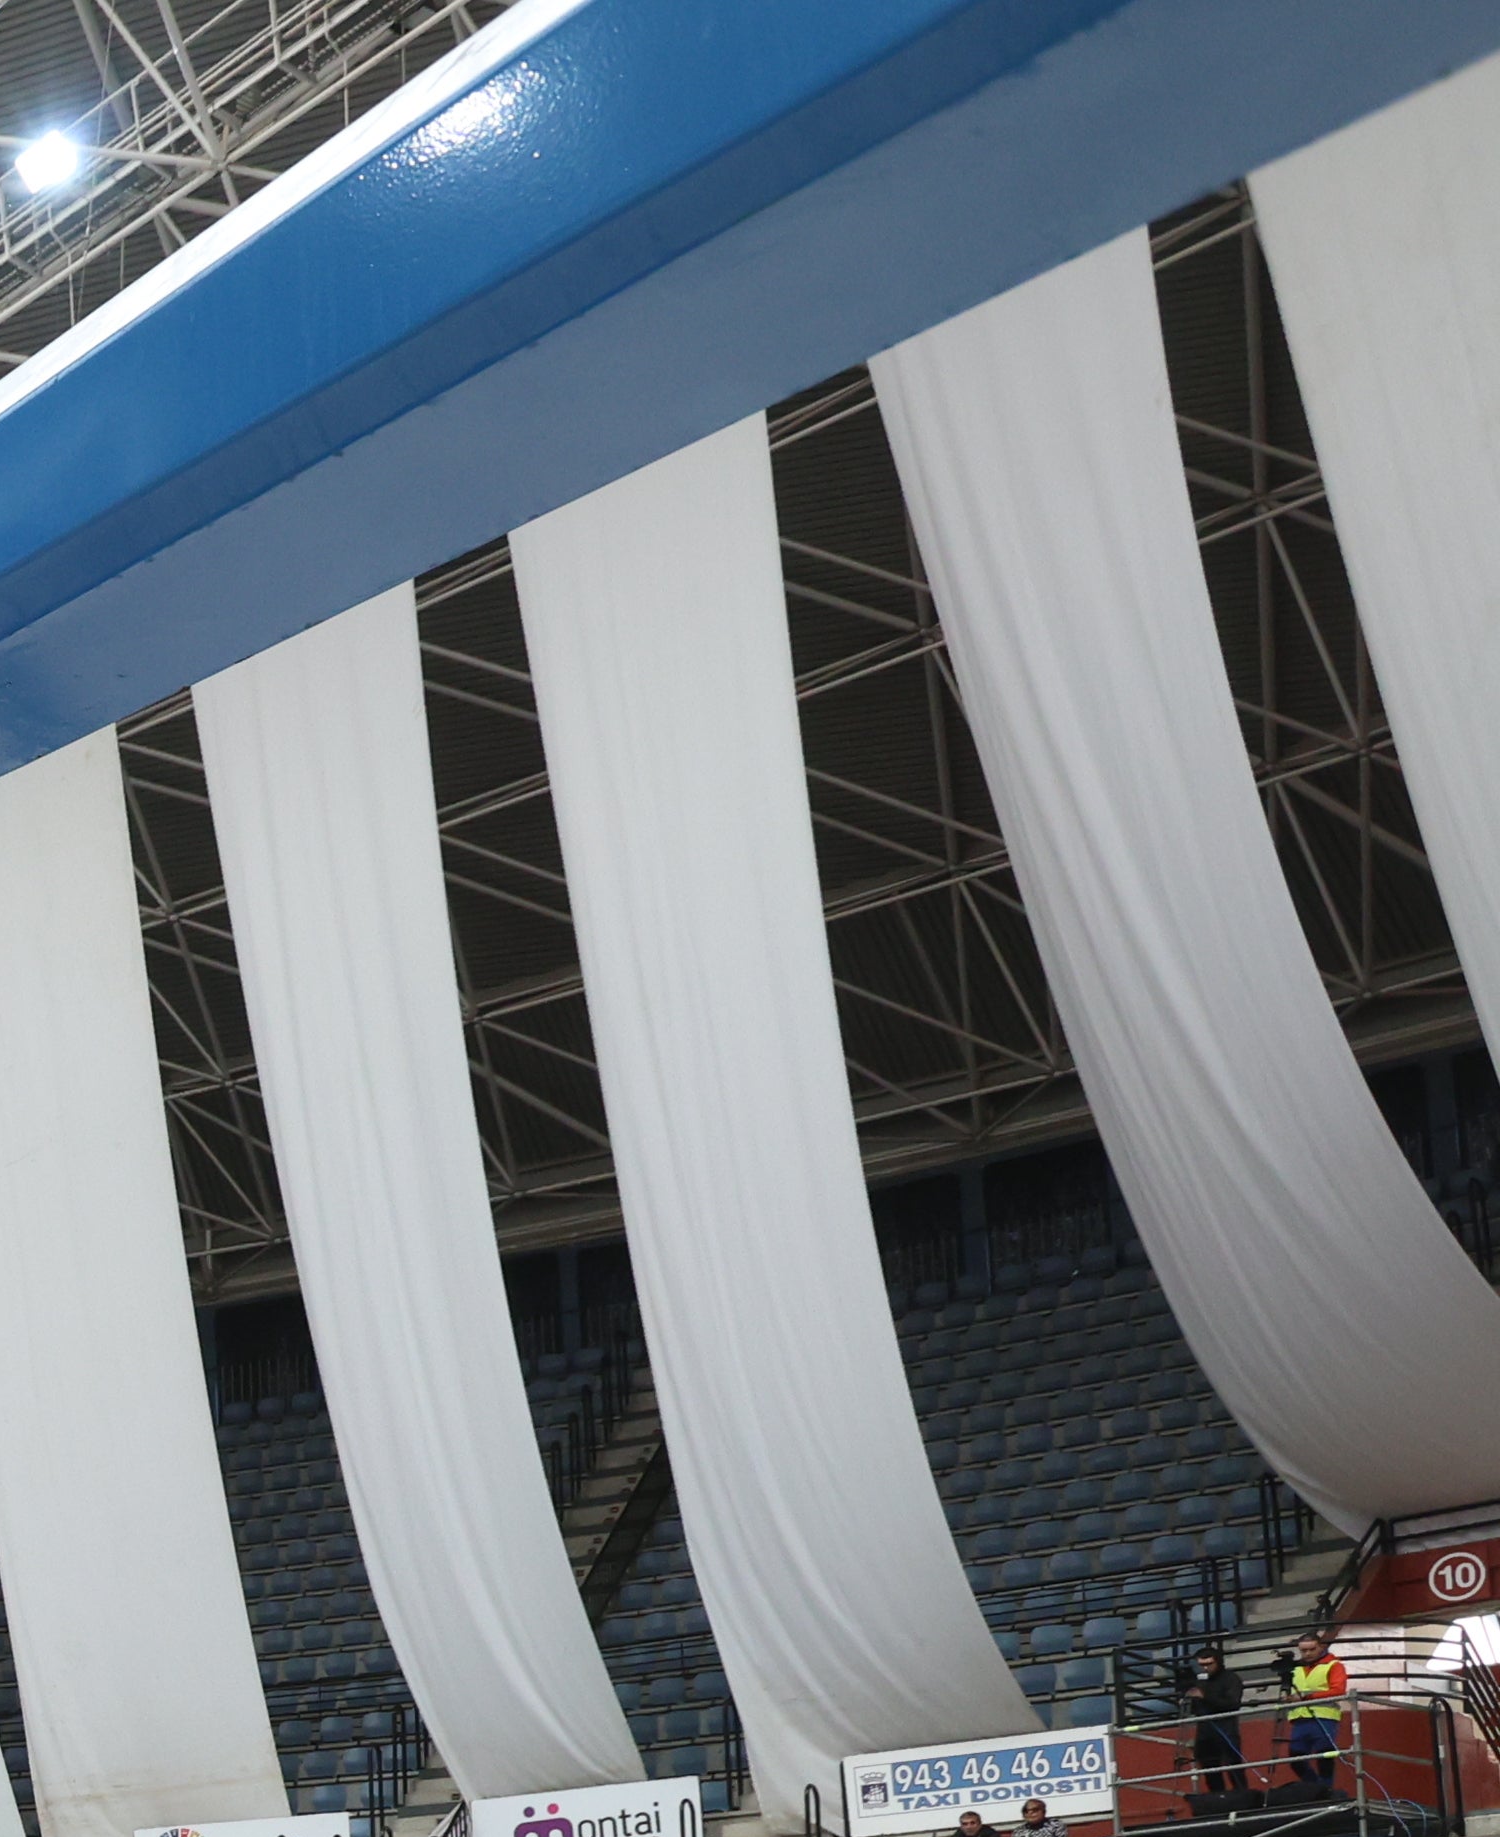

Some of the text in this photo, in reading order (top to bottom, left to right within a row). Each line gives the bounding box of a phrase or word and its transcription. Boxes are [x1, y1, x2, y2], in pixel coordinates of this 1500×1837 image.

[1437, 1561, 1479, 1591] 10
[896, 1743, 1102, 1792] 943 46 46 46
[898, 1776, 1102, 1811] TAXI DONOSTI
